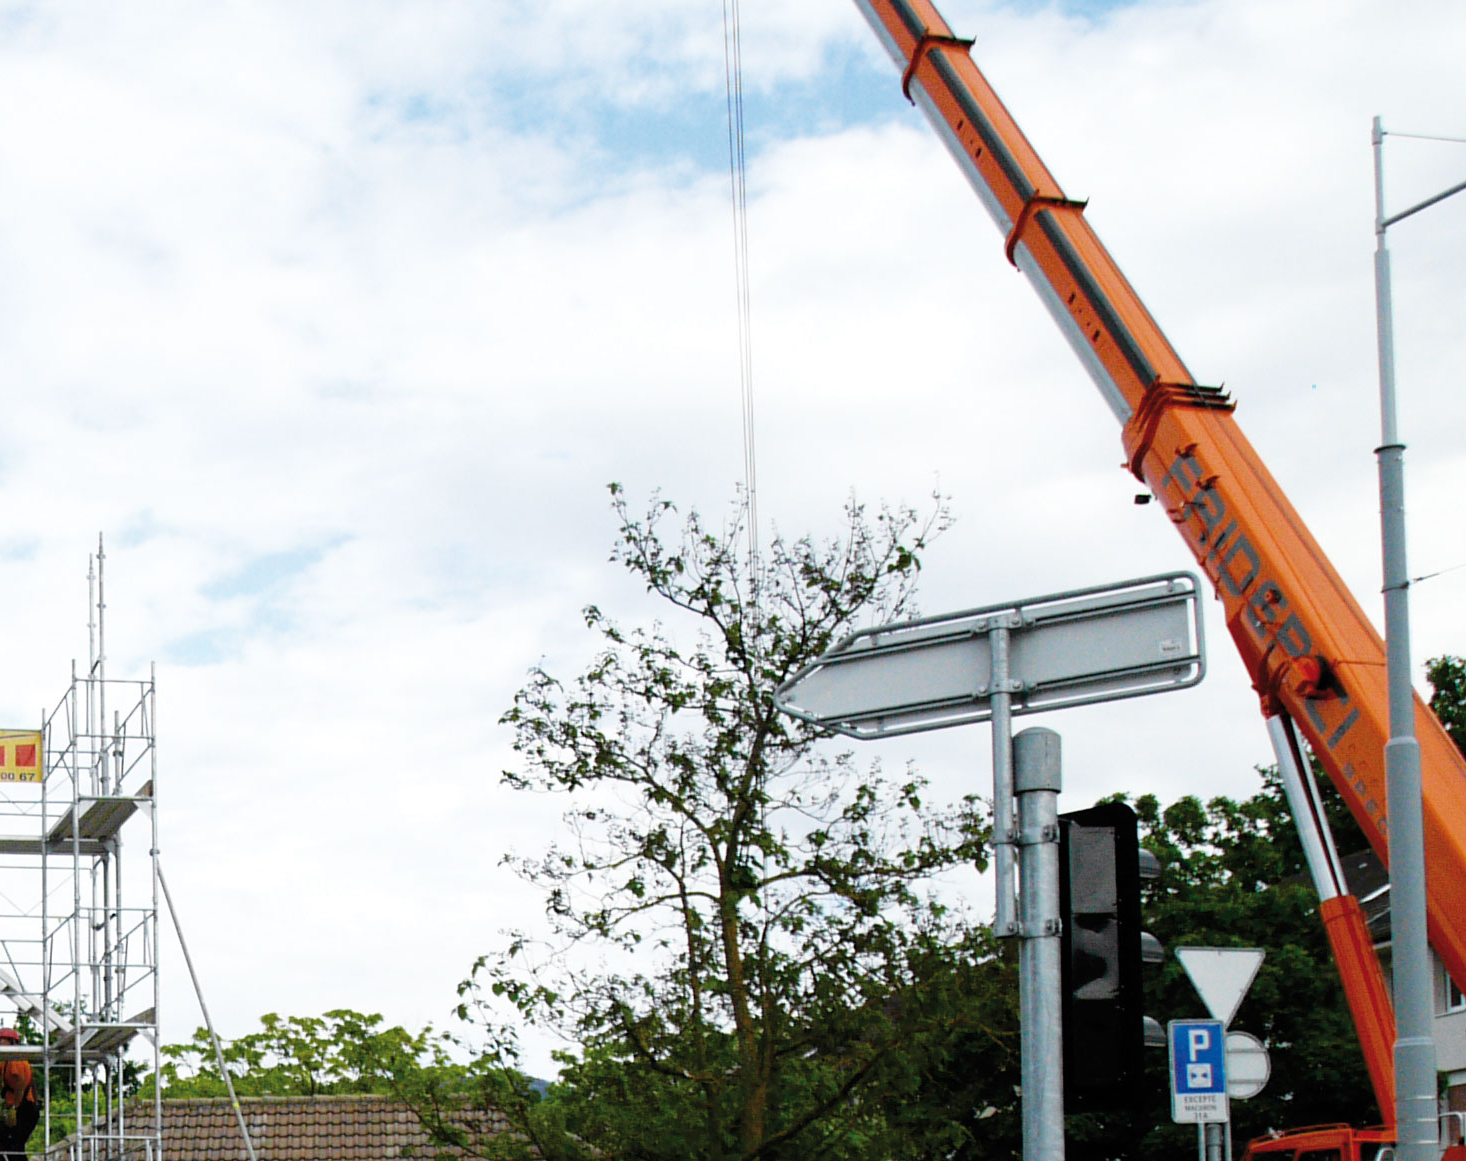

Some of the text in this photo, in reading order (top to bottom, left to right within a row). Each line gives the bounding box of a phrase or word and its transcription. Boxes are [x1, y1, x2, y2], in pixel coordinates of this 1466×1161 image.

[1, 772, 15, 780] 00
[19, 772, 35, 781] 67
[1189, 1030, 1209, 1062] P
